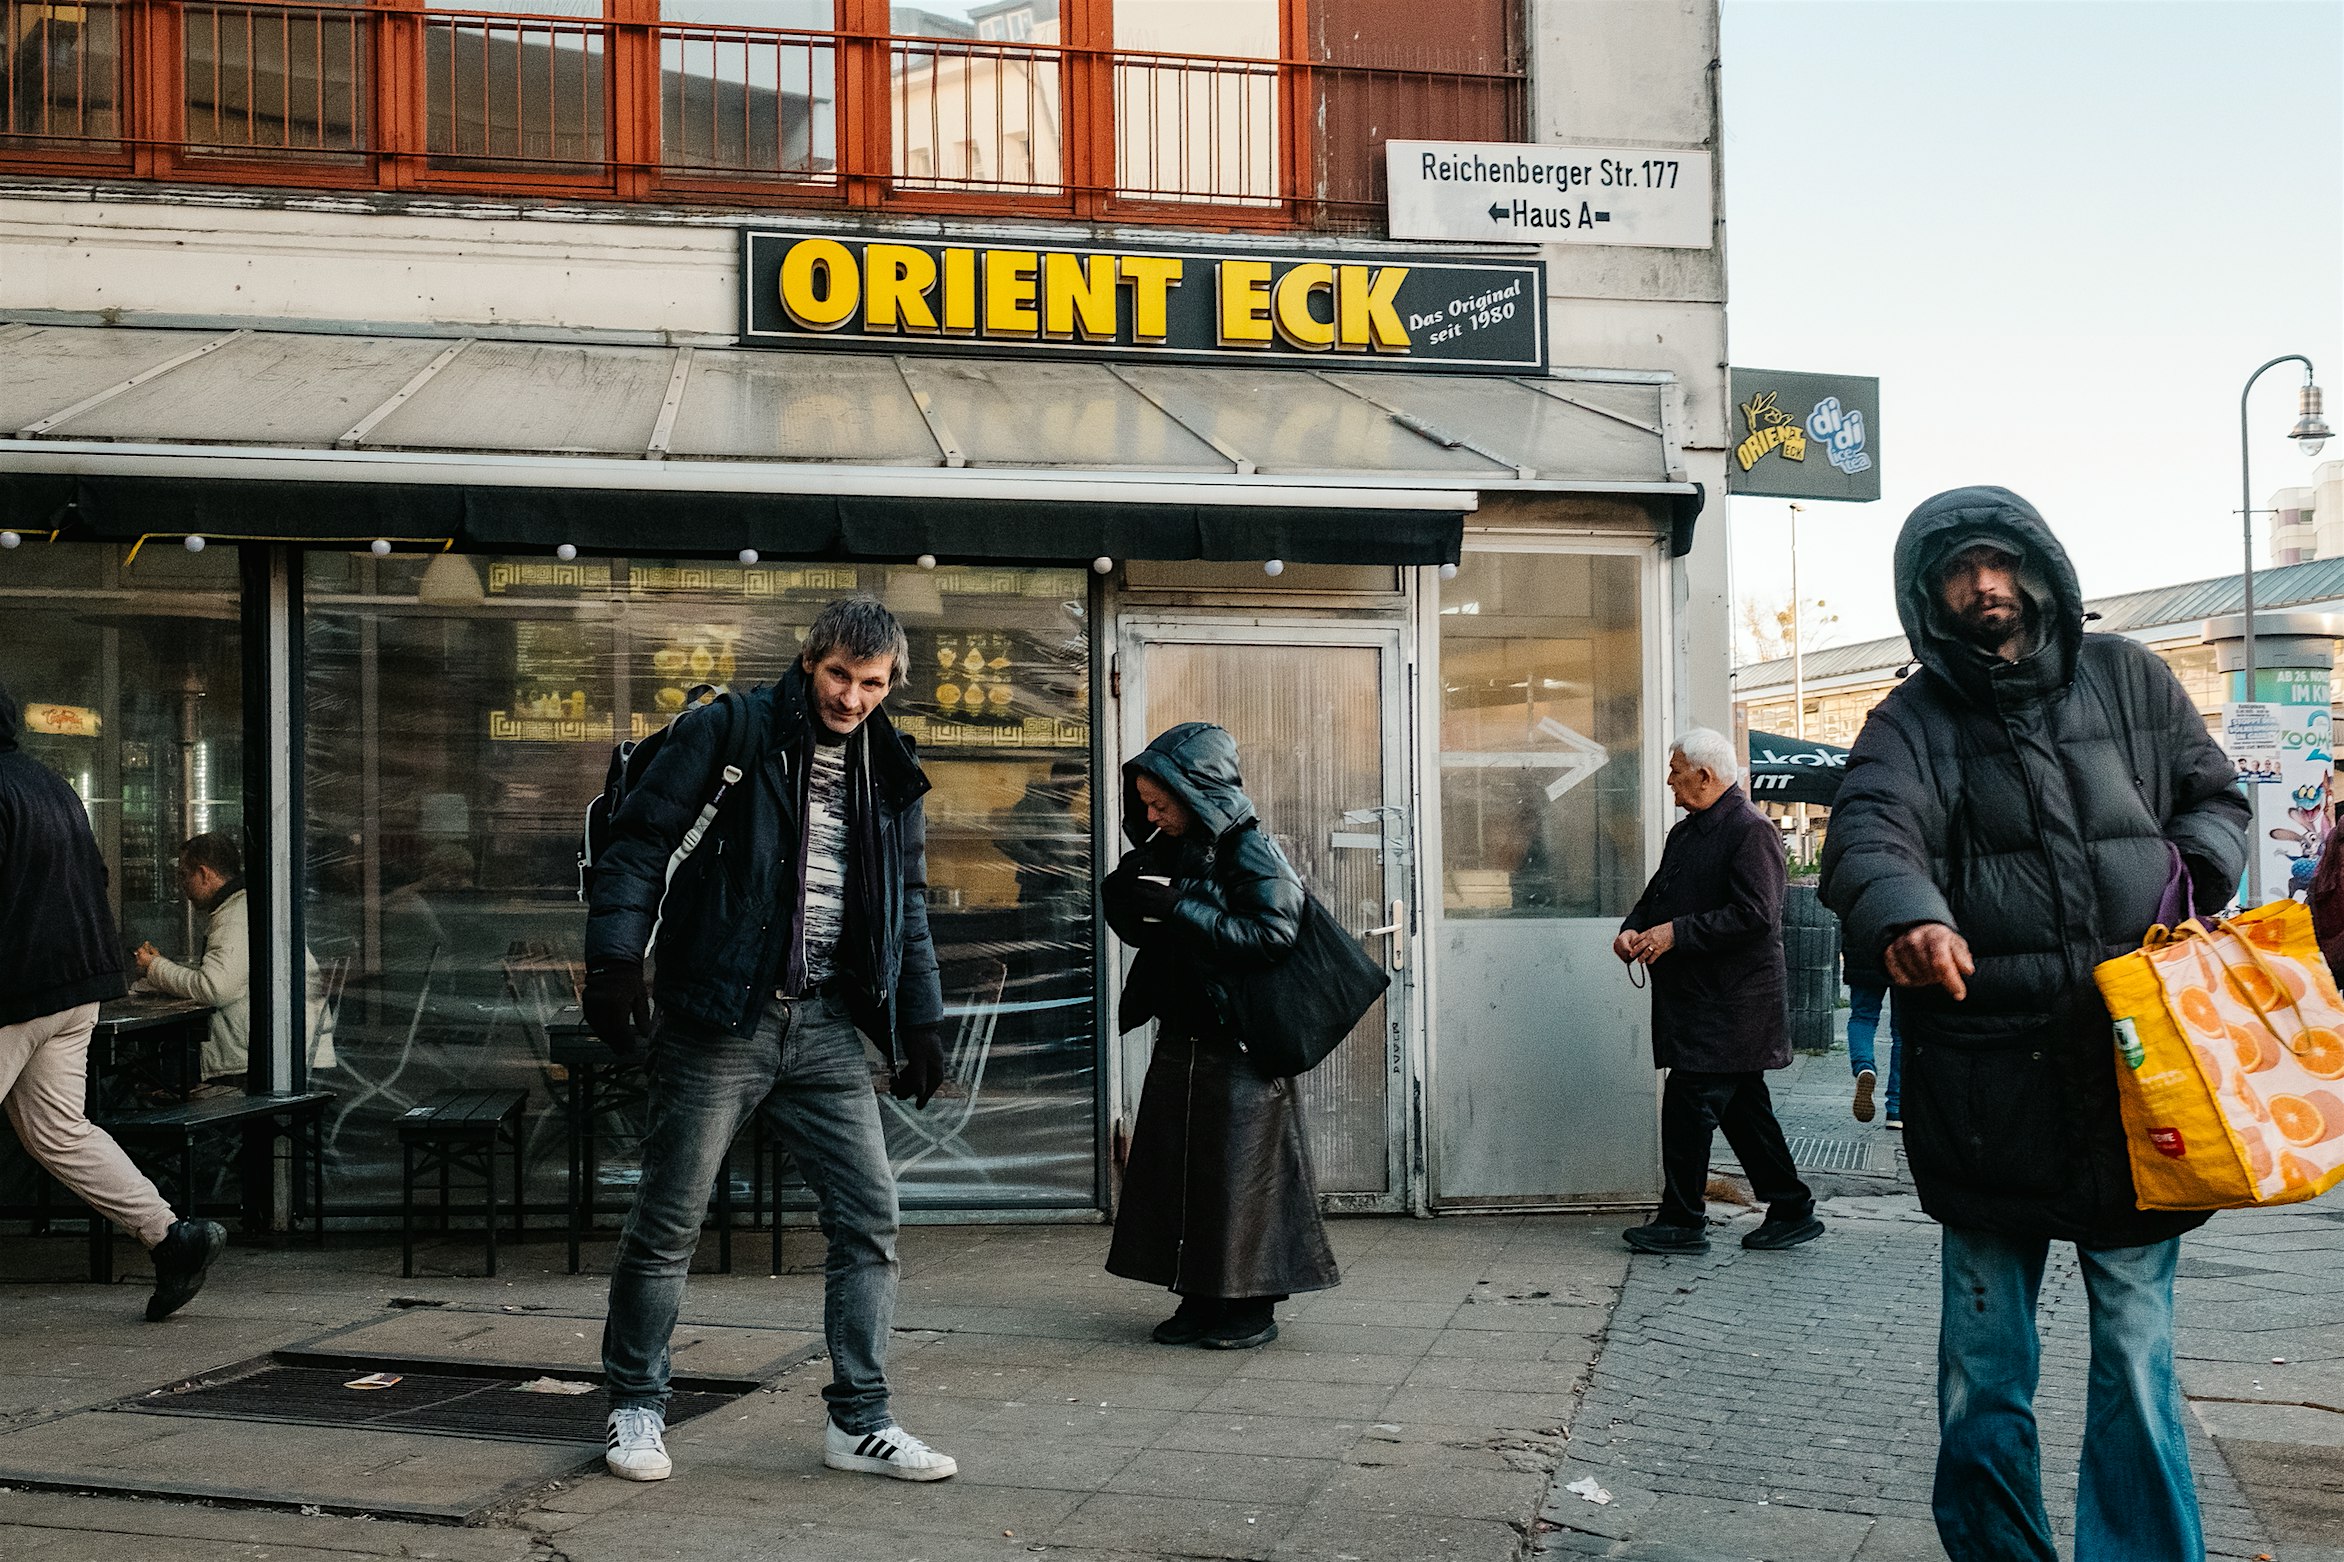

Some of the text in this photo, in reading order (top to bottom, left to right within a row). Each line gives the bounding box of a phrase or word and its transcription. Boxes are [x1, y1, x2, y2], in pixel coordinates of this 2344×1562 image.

[1422, 152, 1592, 192] Reichenberger
[1513, 199, 1593, 229] Haus A
[778, 238, 1411, 354] ORIENT ECK
[1409, 278, 1521, 331] Das Original
[1429, 303, 1516, 346] seit 1980
[1737, 425, 1804, 471] ORIENT
[1784, 444, 1805, 458] ECK
[2292, 684, 2310, 702] IM
